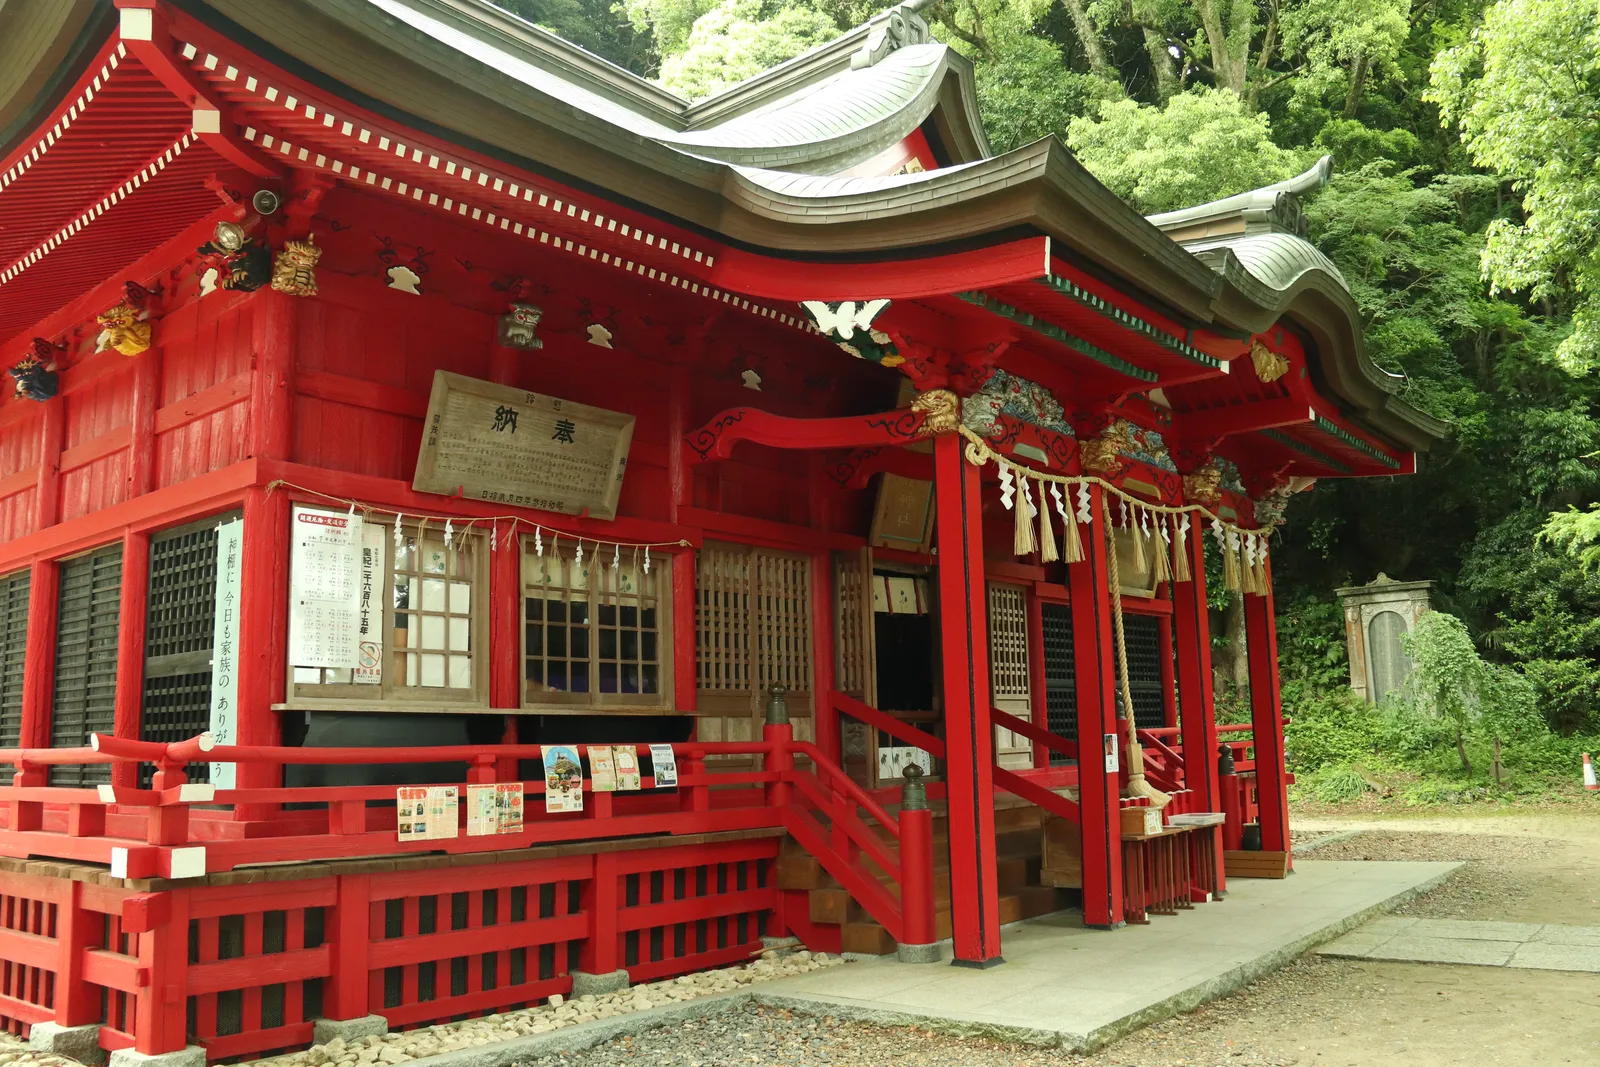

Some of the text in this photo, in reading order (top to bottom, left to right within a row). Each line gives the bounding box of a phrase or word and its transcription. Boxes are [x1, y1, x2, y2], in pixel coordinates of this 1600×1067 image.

[491, 404, 575, 445] 奉納
[359, 547, 373, 636] 皇紀二千六百八十五年
[213, 538, 238, 778] 神棚に 今日も家族の ありがう
